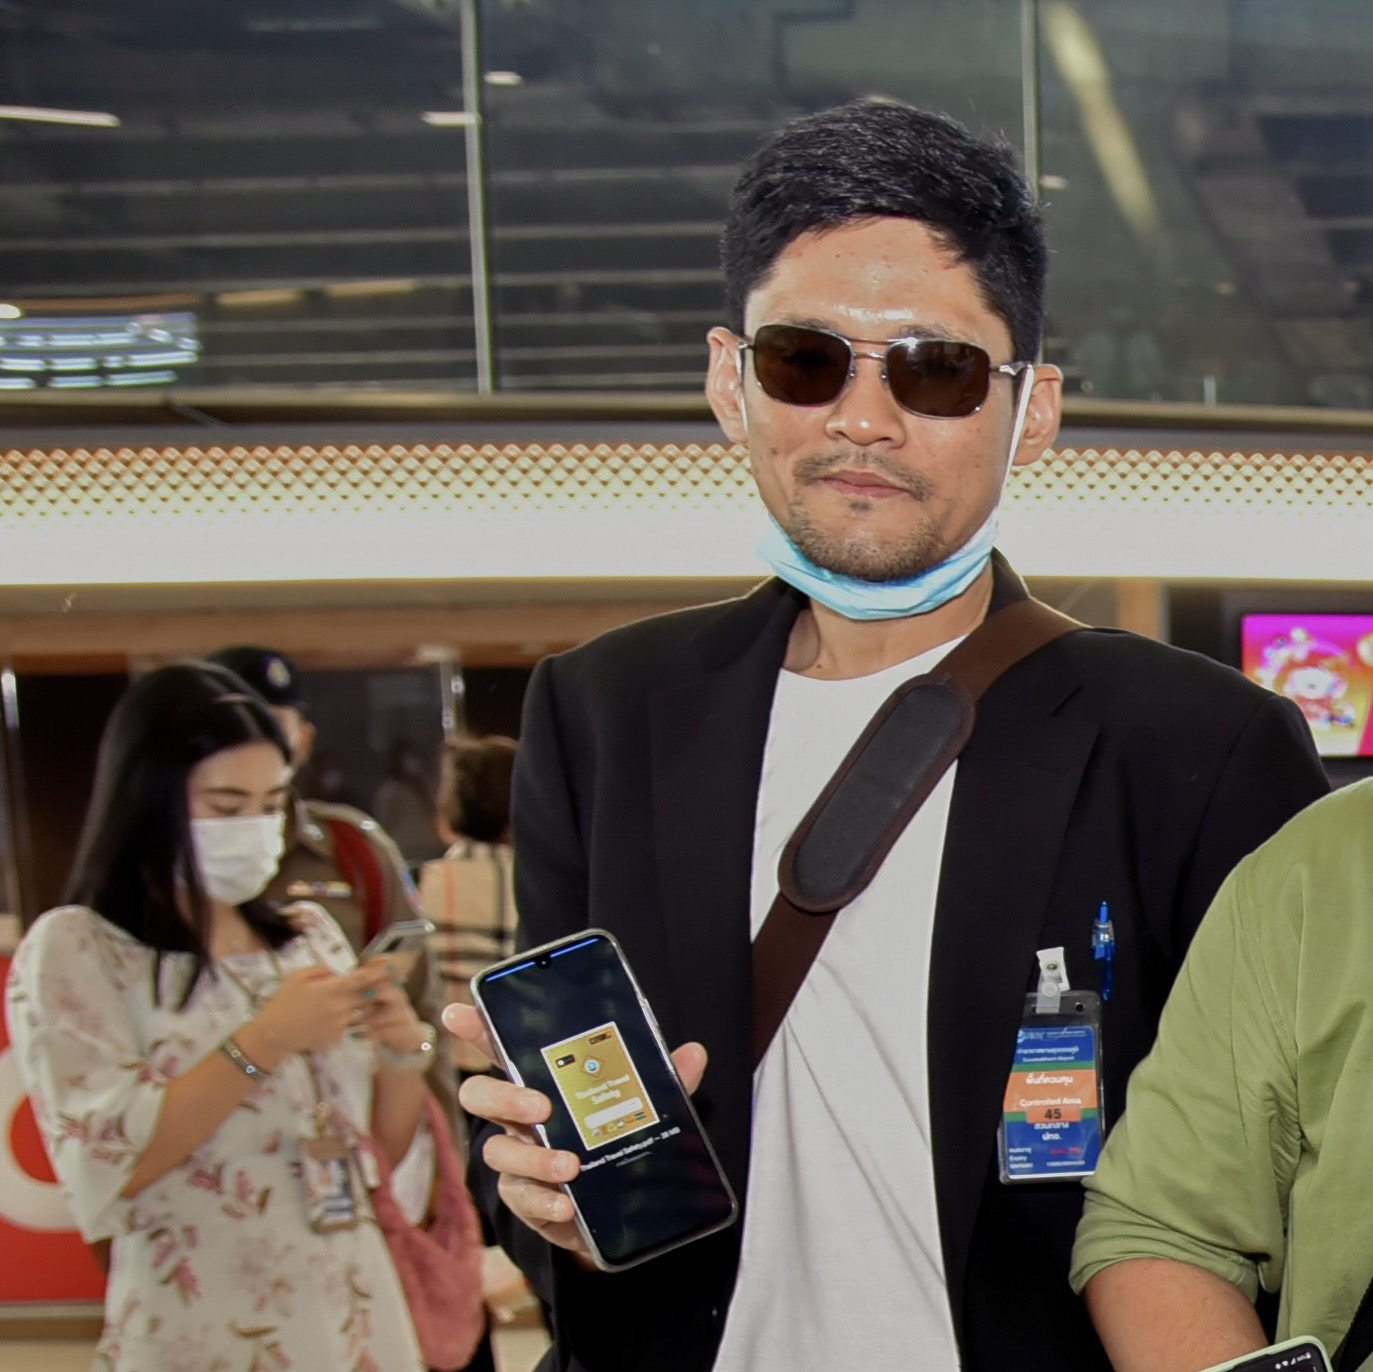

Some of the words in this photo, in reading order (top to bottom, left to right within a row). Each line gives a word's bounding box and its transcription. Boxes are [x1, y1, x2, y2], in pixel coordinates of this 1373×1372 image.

[1020, 1097, 1061, 1108] Controlled
[1062, 1097, 1082, 1105] Area
[1044, 1108, 1062, 1119] 45
